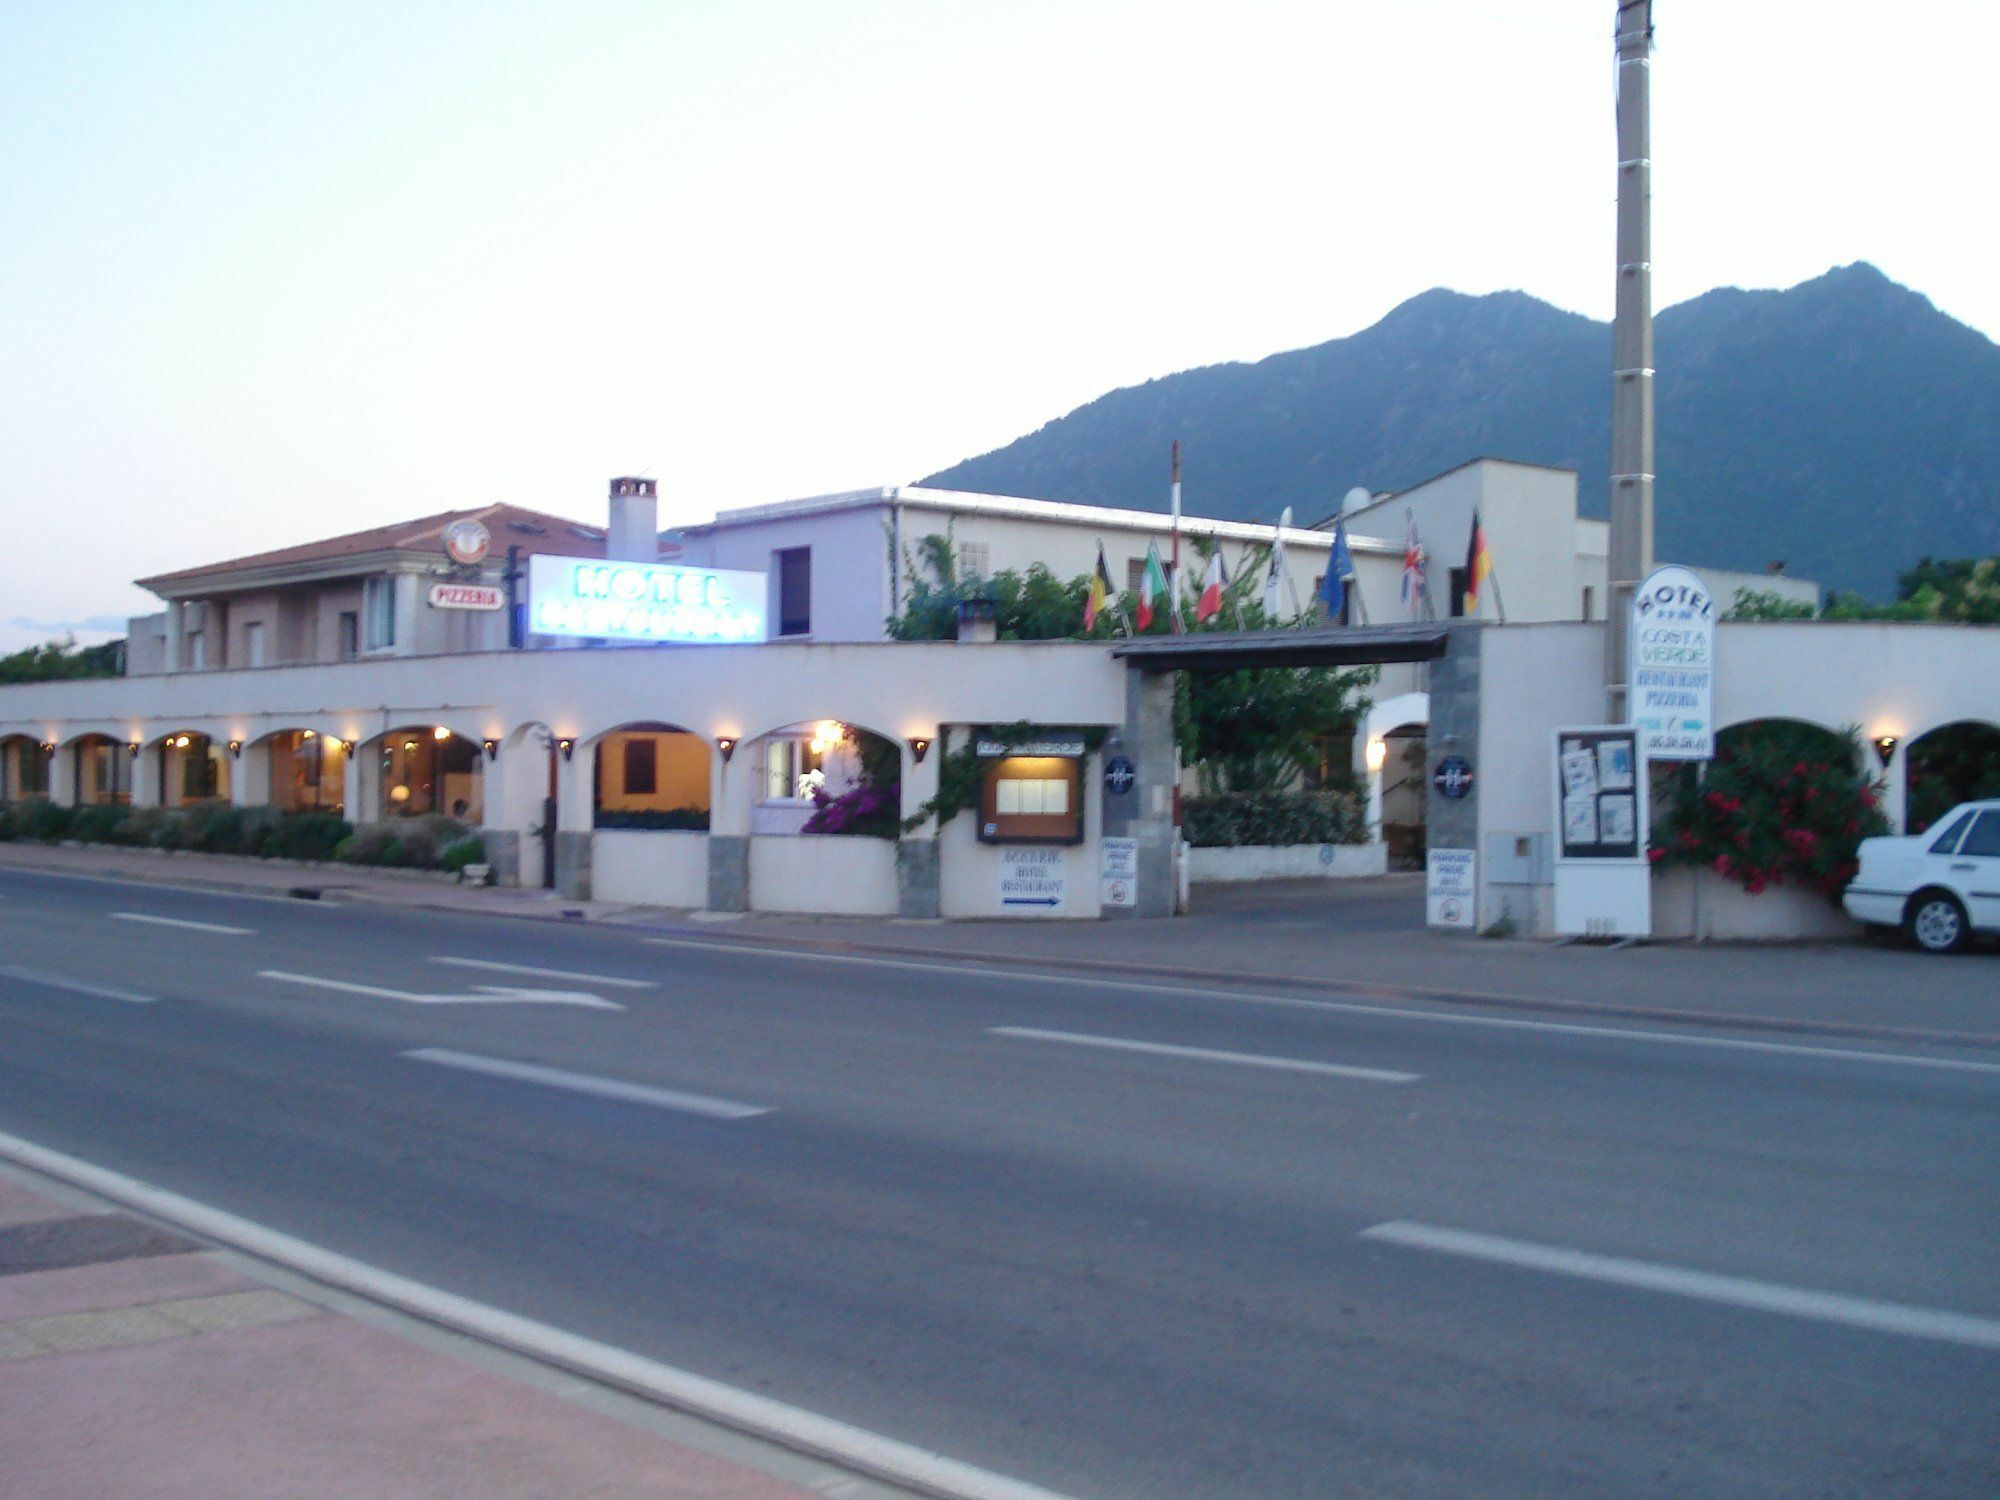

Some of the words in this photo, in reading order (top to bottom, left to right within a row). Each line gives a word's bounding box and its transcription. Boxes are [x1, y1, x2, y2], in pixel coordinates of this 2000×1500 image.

[575, 565, 731, 606] HOTEL
[437, 588, 498, 605] PIZZERIA
[1637, 586, 1712, 619] HOTEL
[1642, 628, 1707, 645] COSTA
[1642, 646, 1709, 663] VERDE
